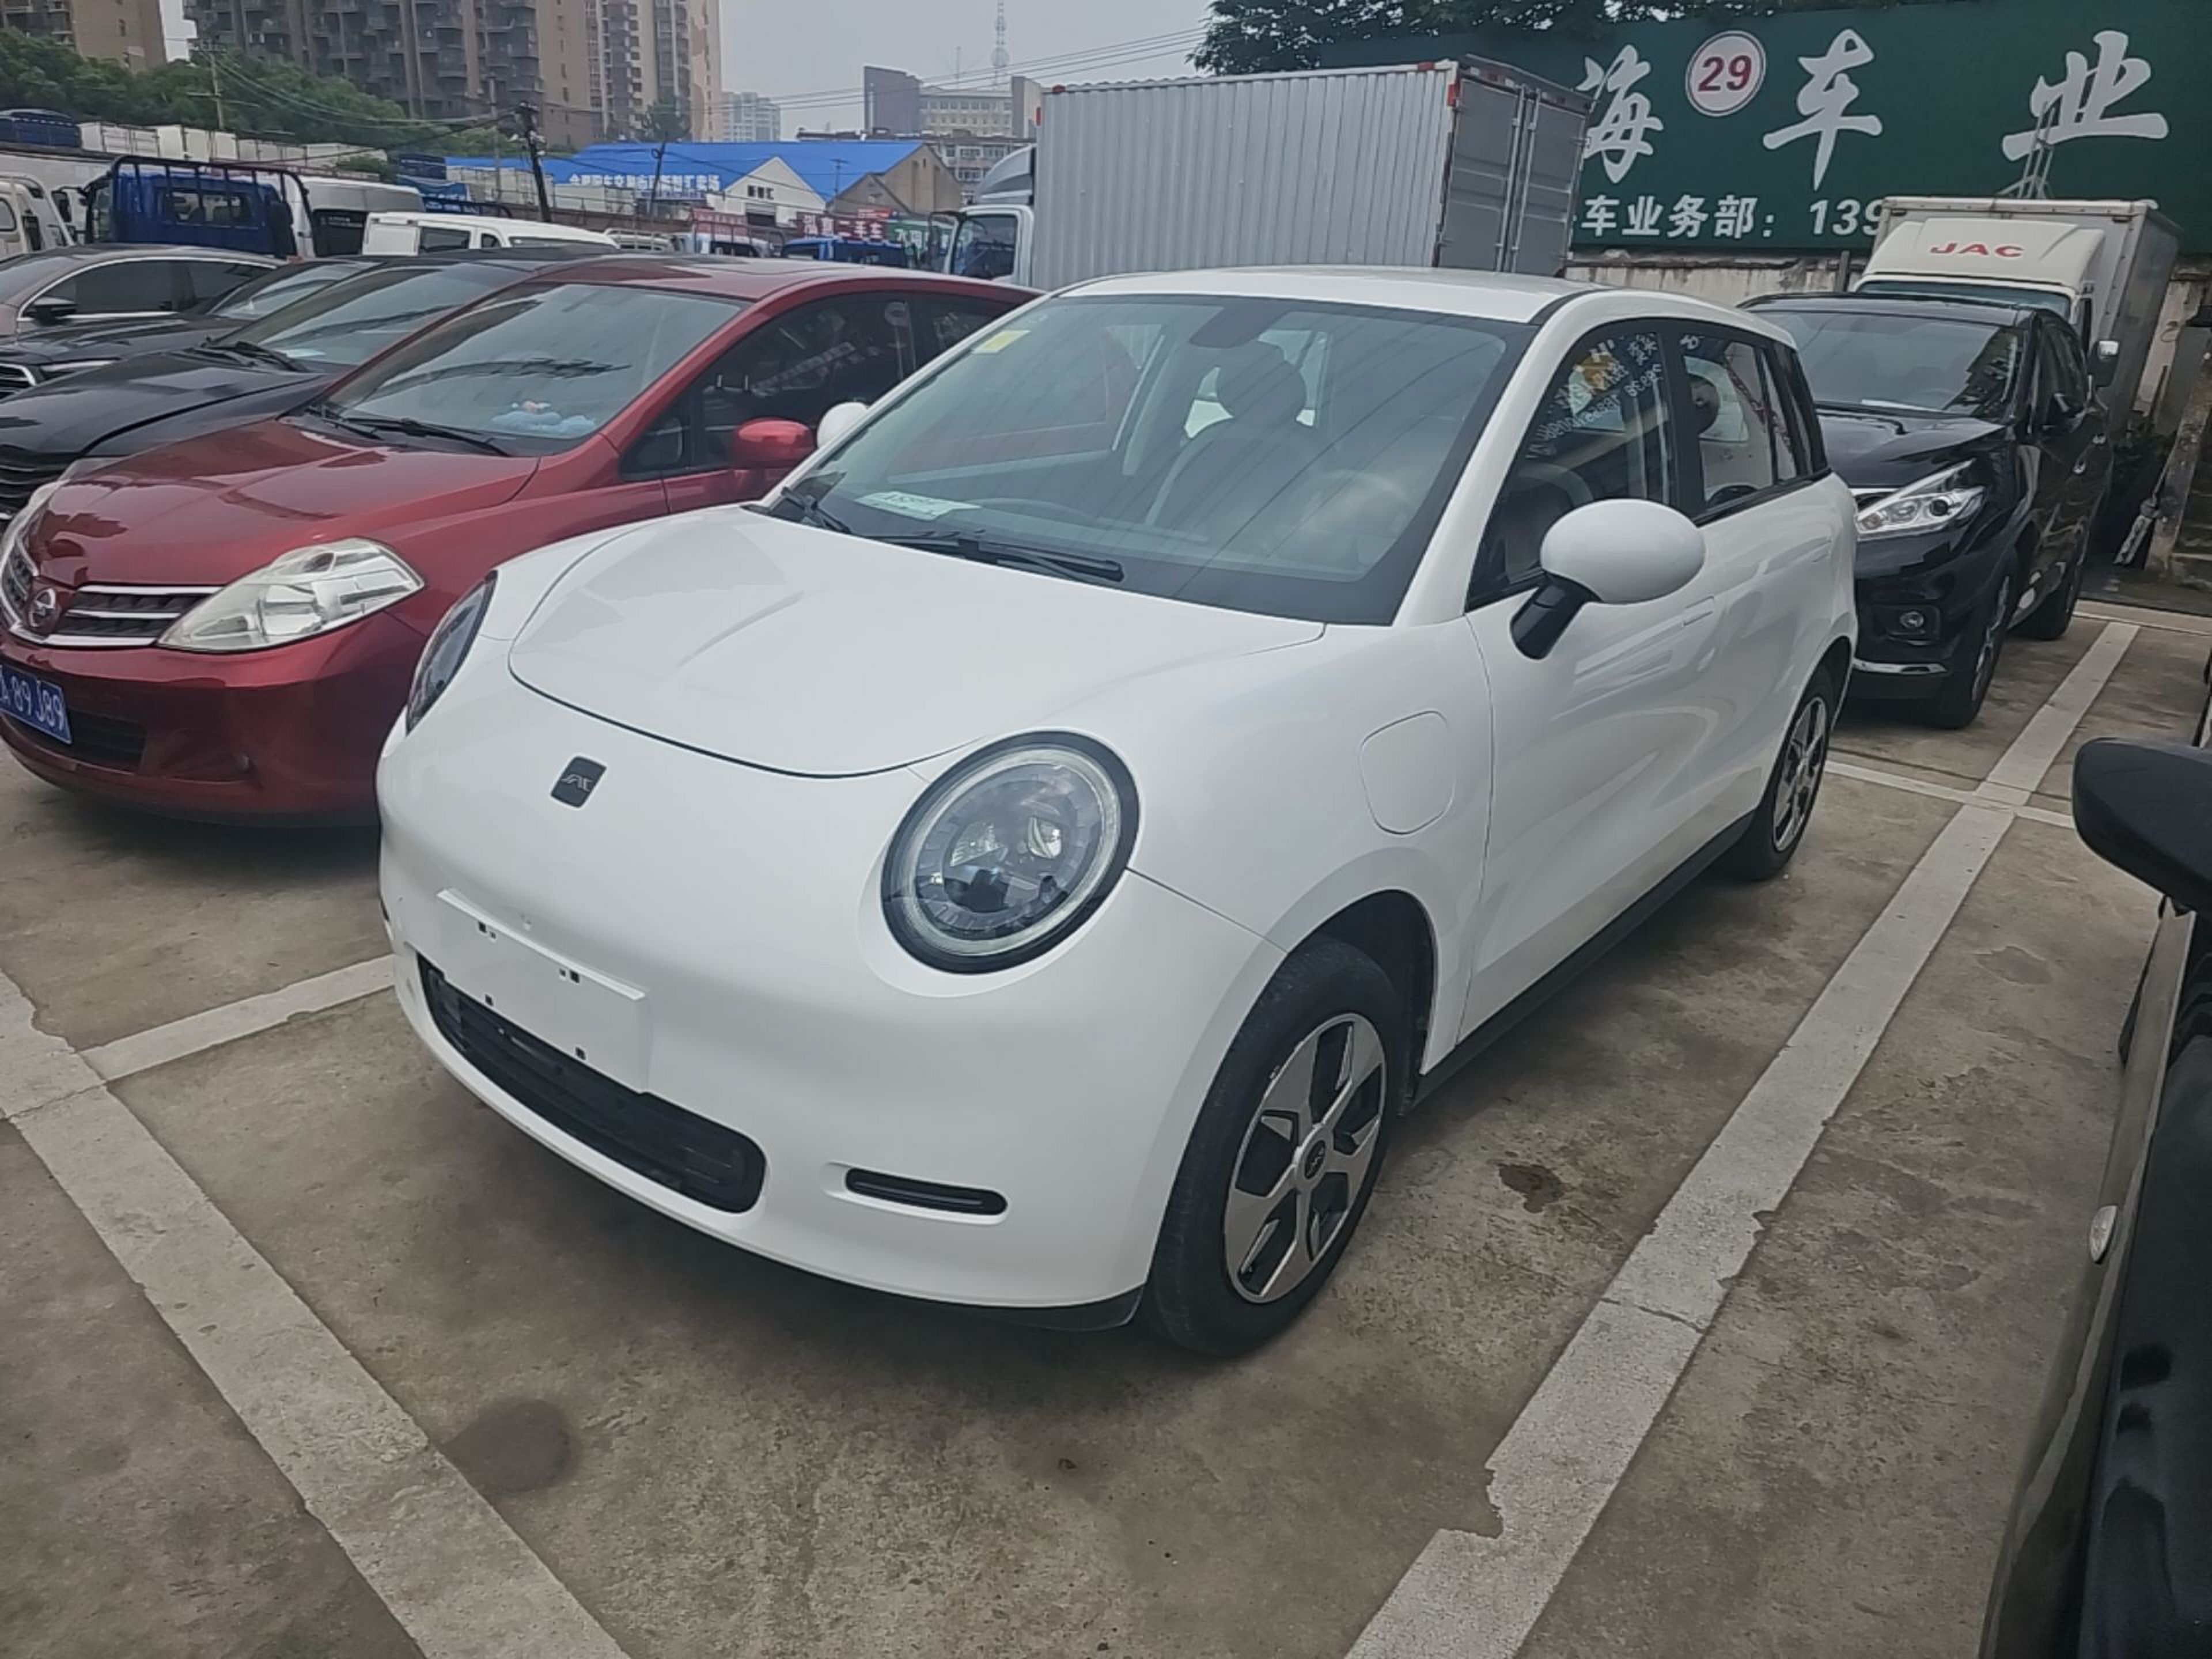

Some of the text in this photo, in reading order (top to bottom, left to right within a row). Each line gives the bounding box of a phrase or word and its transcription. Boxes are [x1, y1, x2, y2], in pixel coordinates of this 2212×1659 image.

[1696, 55, 1752, 92] 29
[1572, 194, 1775, 238] 车业务部：
[1930, 243, 2024, 257] JAC
